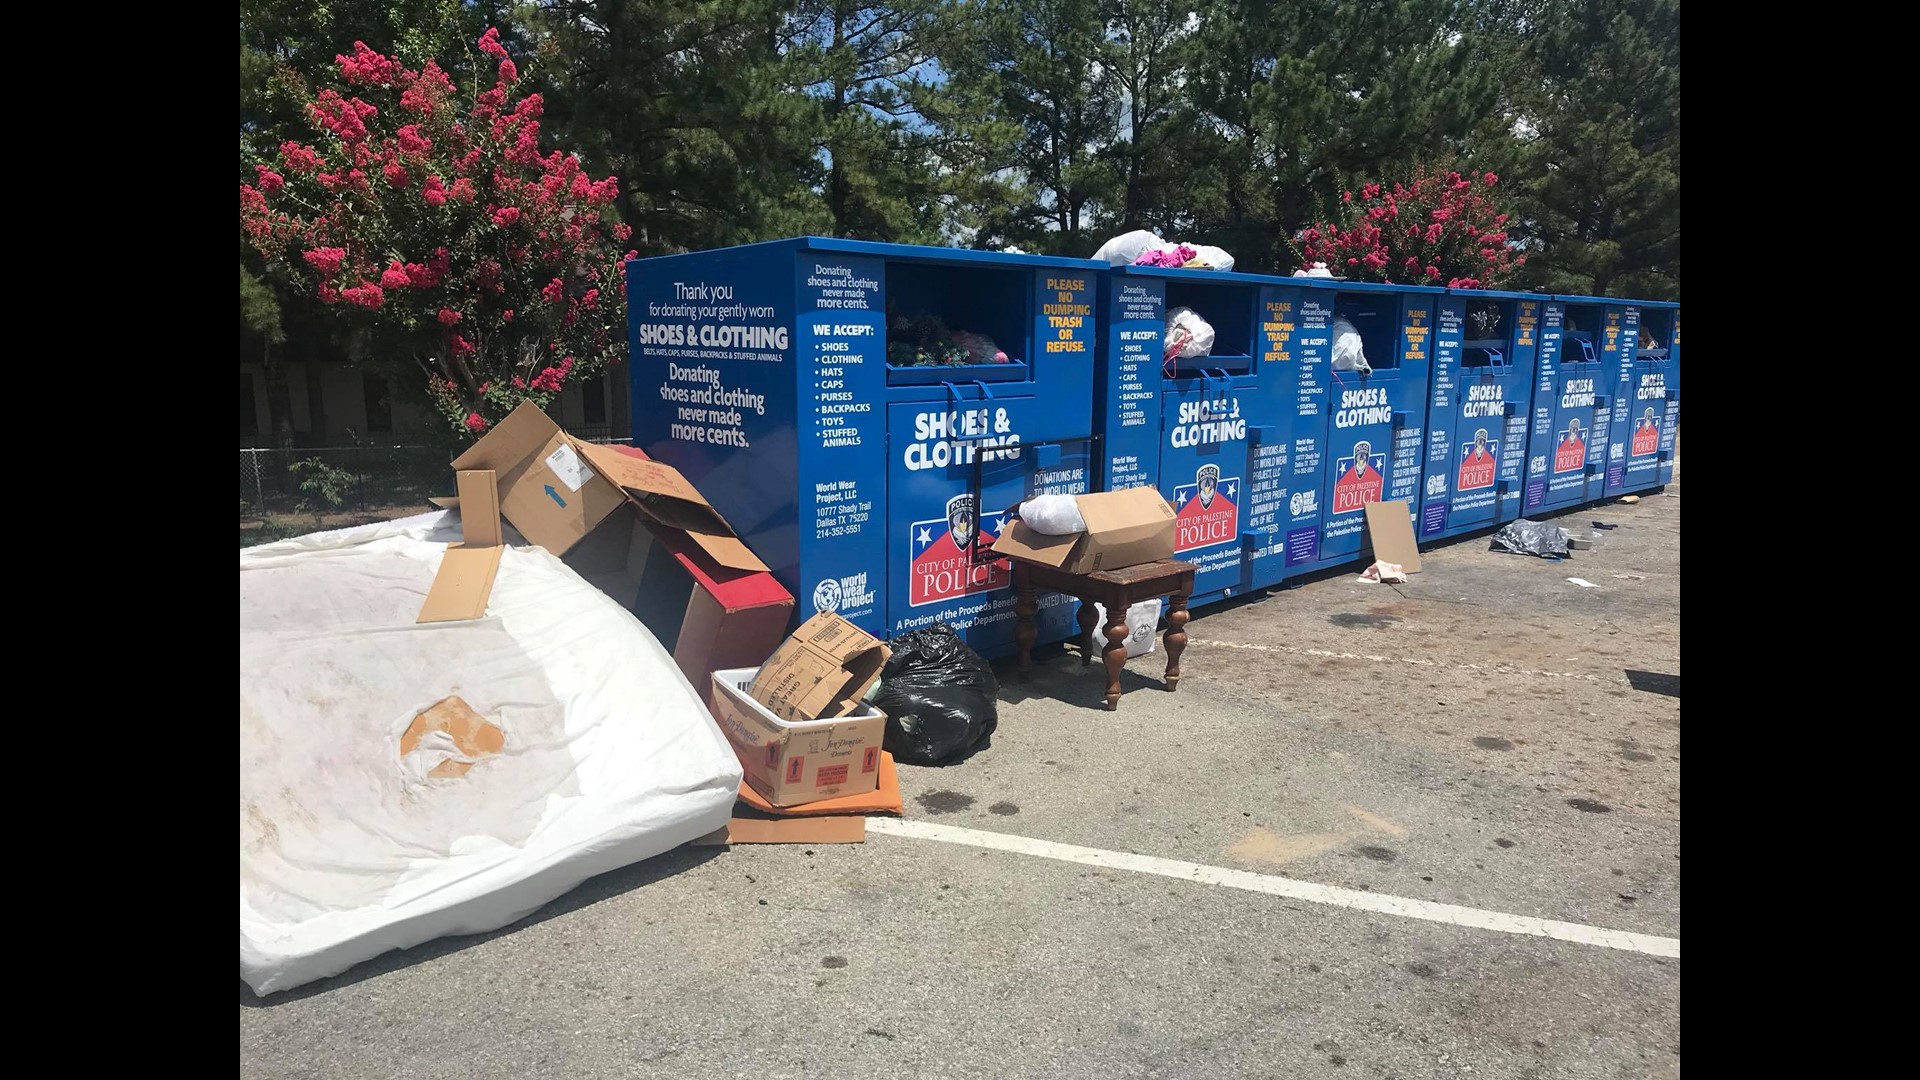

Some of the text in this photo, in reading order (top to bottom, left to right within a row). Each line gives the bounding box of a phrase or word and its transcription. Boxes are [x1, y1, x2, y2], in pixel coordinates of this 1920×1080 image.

[815, 264, 852, 280] Donating
[807, 275, 879, 292] shoes and clothing
[1046, 278, 1085, 291] PLEASE
[674, 282, 733, 304] Thank you
[822, 288, 865, 298] never made
[1058, 291, 1073, 303] NO
[1123, 285, 1146, 297] Donating
[816, 298, 869, 309] more cents.
[1118, 295, 1162, 306] shoes and clothing
[1266, 302, 1292, 312] PLEASE
[649, 302, 775, 321] for donating your gently worn
[1043, 304, 1091, 316] DUMPING
[1123, 311, 1156, 320] more cents.
[1048, 316, 1083, 328] TRASH
[1273, 312, 1284, 322] NO
[813, 324, 874, 336] WE ACCEPT:
[1263, 322, 1295, 332] DUMPING
[640, 324, 788, 350] SHOES & CLOTHING
[1058, 329, 1073, 340] OR
[1120, 331, 1158, 340] WE ACCEPT:
[1266, 332, 1290, 342] TRASH
[821, 342, 849, 352] SHOES
[1046, 341, 1086, 353] REFUSE.
[1273, 342, 1283, 352] OR
[681, 350, 700, 358] PURSES,
[700, 350, 728, 360] BACKPACKS
[729, 352, 733, 360] &
[733, 352, 757, 361] STUFFED
[757, 353, 783, 362] ANIMALS
[821, 354, 864, 364] CLOTHING
[1123, 354, 1151, 362] CLOTHING
[1264, 352, 1291, 362] REFUSE.
[821, 367, 843, 377] HATS
[1123, 364, 1137, 372] HATS
[669, 362, 720, 390] Donating
[821, 380, 844, 389] CAPS
[1122, 383, 1143, 391] PURSES
[1565, 378, 1594, 394] SHOES &
[660, 382, 765, 416] shoes and clothing
[821, 392, 853, 402] PURSES
[1122, 391, 1154, 401] BACKPACKS
[1341, 387, 1388, 409] SHOES &
[1468, 385, 1503, 402] SHOES &
[1637, 386, 1666, 400] CLOTHING
[1122, 402, 1137, 410] TOYS
[1561, 393, 1595, 409] CLOTHING
[821, 403, 871, 414] BACKPACKS
[1122, 411, 1144, 419] STUFFED
[1178, 397, 1240, 425] SHOES &
[1463, 401, 1505, 418] CLOTHING
[678, 407, 742, 426] never made
[821, 416, 844, 426] TOYS
[1121, 418, 1146, 427] ANIMALS
[1335, 405, 1392, 429] CLOTHING
[914, 407, 1011, 441] SHOES &
[671, 423, 750, 448] more cents.
[822, 427, 858, 439] STUFFED
[1171, 419, 1246, 449] CLOTHING
[822, 436, 862, 448] ANIMALS
[1635, 440, 1654, 453] POLICE
[1557, 454, 1581, 469] POLICE
[1034, 468, 1084, 486] DONATIONS ARE
[1200, 465, 1218, 476] POLICE
[1462, 469, 1490, 487] POLICE
[815, 481, 856, 493] World Wear
[1067, 481, 1085, 495] WEAR
[1336, 480, 1380, 493] CITY OF PALESTINE
[816, 489, 857, 504] Project, LLC
[1339, 488, 1376, 509] POLICE
[816, 501, 872, 518] 10777 Shady Trail
[950, 498, 974, 511] POLIC
[816, 512, 869, 529] Dallas TX 75220
[1176, 509, 1233, 528] CITY OF PALESTINE
[816, 523, 861, 539] 214-352-5551
[1179, 519, 1229, 546] POLICE
[1202, 550, 1225, 563] Proceeds
[916, 562, 941, 575] CITY
[941, 558, 956, 570] OF
[1211, 557, 1241, 571] Department
[840, 571, 867, 588] world
[922, 562, 998, 598] POLICE
[841, 583, 866, 599] wear
[841, 590, 875, 611] project
[896, 620, 903, 631] A
[904, 615, 934, 628] Portion
[935, 610, 944, 623] of
[944, 609, 958, 620] the
[958, 601, 992, 617] Proceeds
[767, 672, 795, 706] DISTILLED
[779, 680, 801, 706] GREAT
